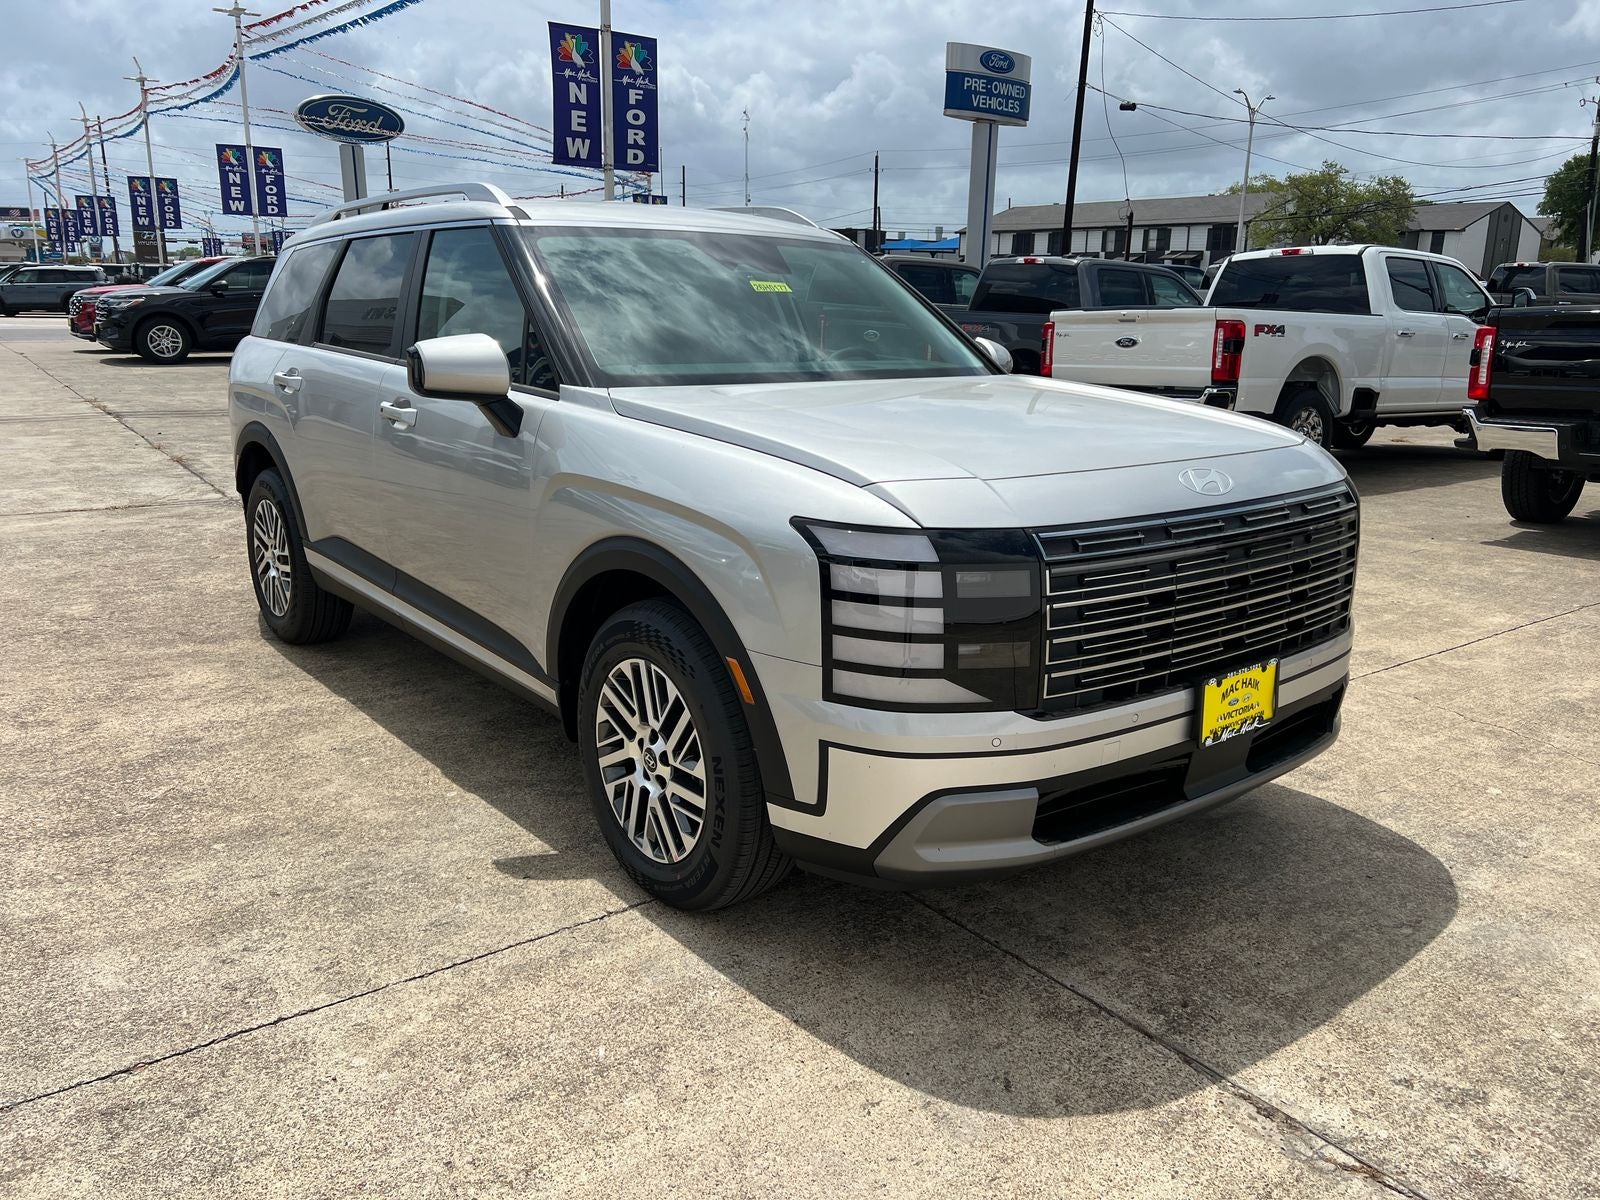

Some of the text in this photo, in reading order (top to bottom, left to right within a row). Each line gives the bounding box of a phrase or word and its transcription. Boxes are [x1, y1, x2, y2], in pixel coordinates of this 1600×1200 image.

[989, 54, 1009, 69] Ford
[964, 77, 1026, 99] PRE-OWNED
[972, 94, 1020, 113] VEHICLES
[324, 104, 383, 131] Ford
[566, 82, 590, 160] NEW
[625, 88, 646, 165] FORD
[228, 172, 245, 212] NEW
[265, 175, 279, 214] FORD
[83, 211, 93, 234] NEW
[136, 196, 149, 226] NEW
[164, 198, 175, 227] FORD
[50, 221, 59, 240] NEW
[68, 222, 76, 241] FORD
[105, 212, 114, 235] FORD
[1254, 324, 1285, 336] FX4
[1221, 680, 1240, 704] MAC
[1241, 678, 1260, 691] HAIK
[1223, 703, 1256, 720] VICTORIA
[711, 756, 727, 849] NEXEN
